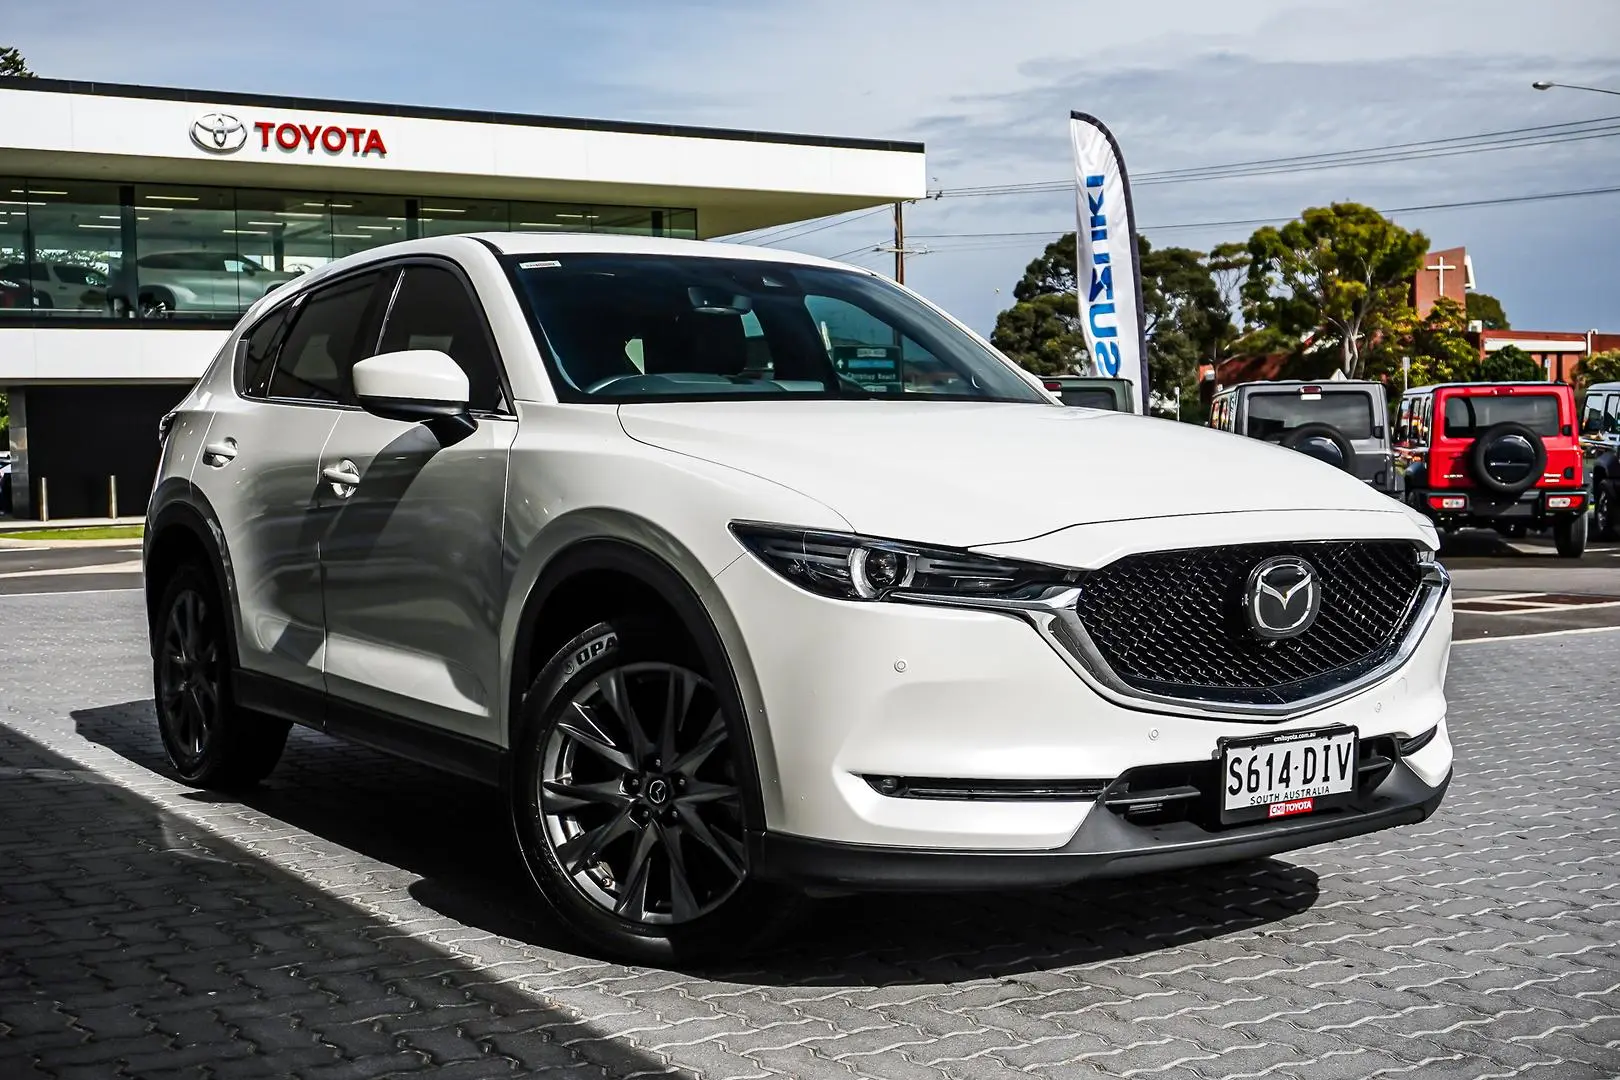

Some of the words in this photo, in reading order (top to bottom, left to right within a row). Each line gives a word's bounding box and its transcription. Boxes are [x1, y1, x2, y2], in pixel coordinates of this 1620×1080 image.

[254, 121, 387, 155] TOYOTA
[1250, 791, 1280, 805] SOUTH
[1283, 785, 1330, 801] AUSTRALIA
[1285, 800, 1313, 813] TOYOTA
